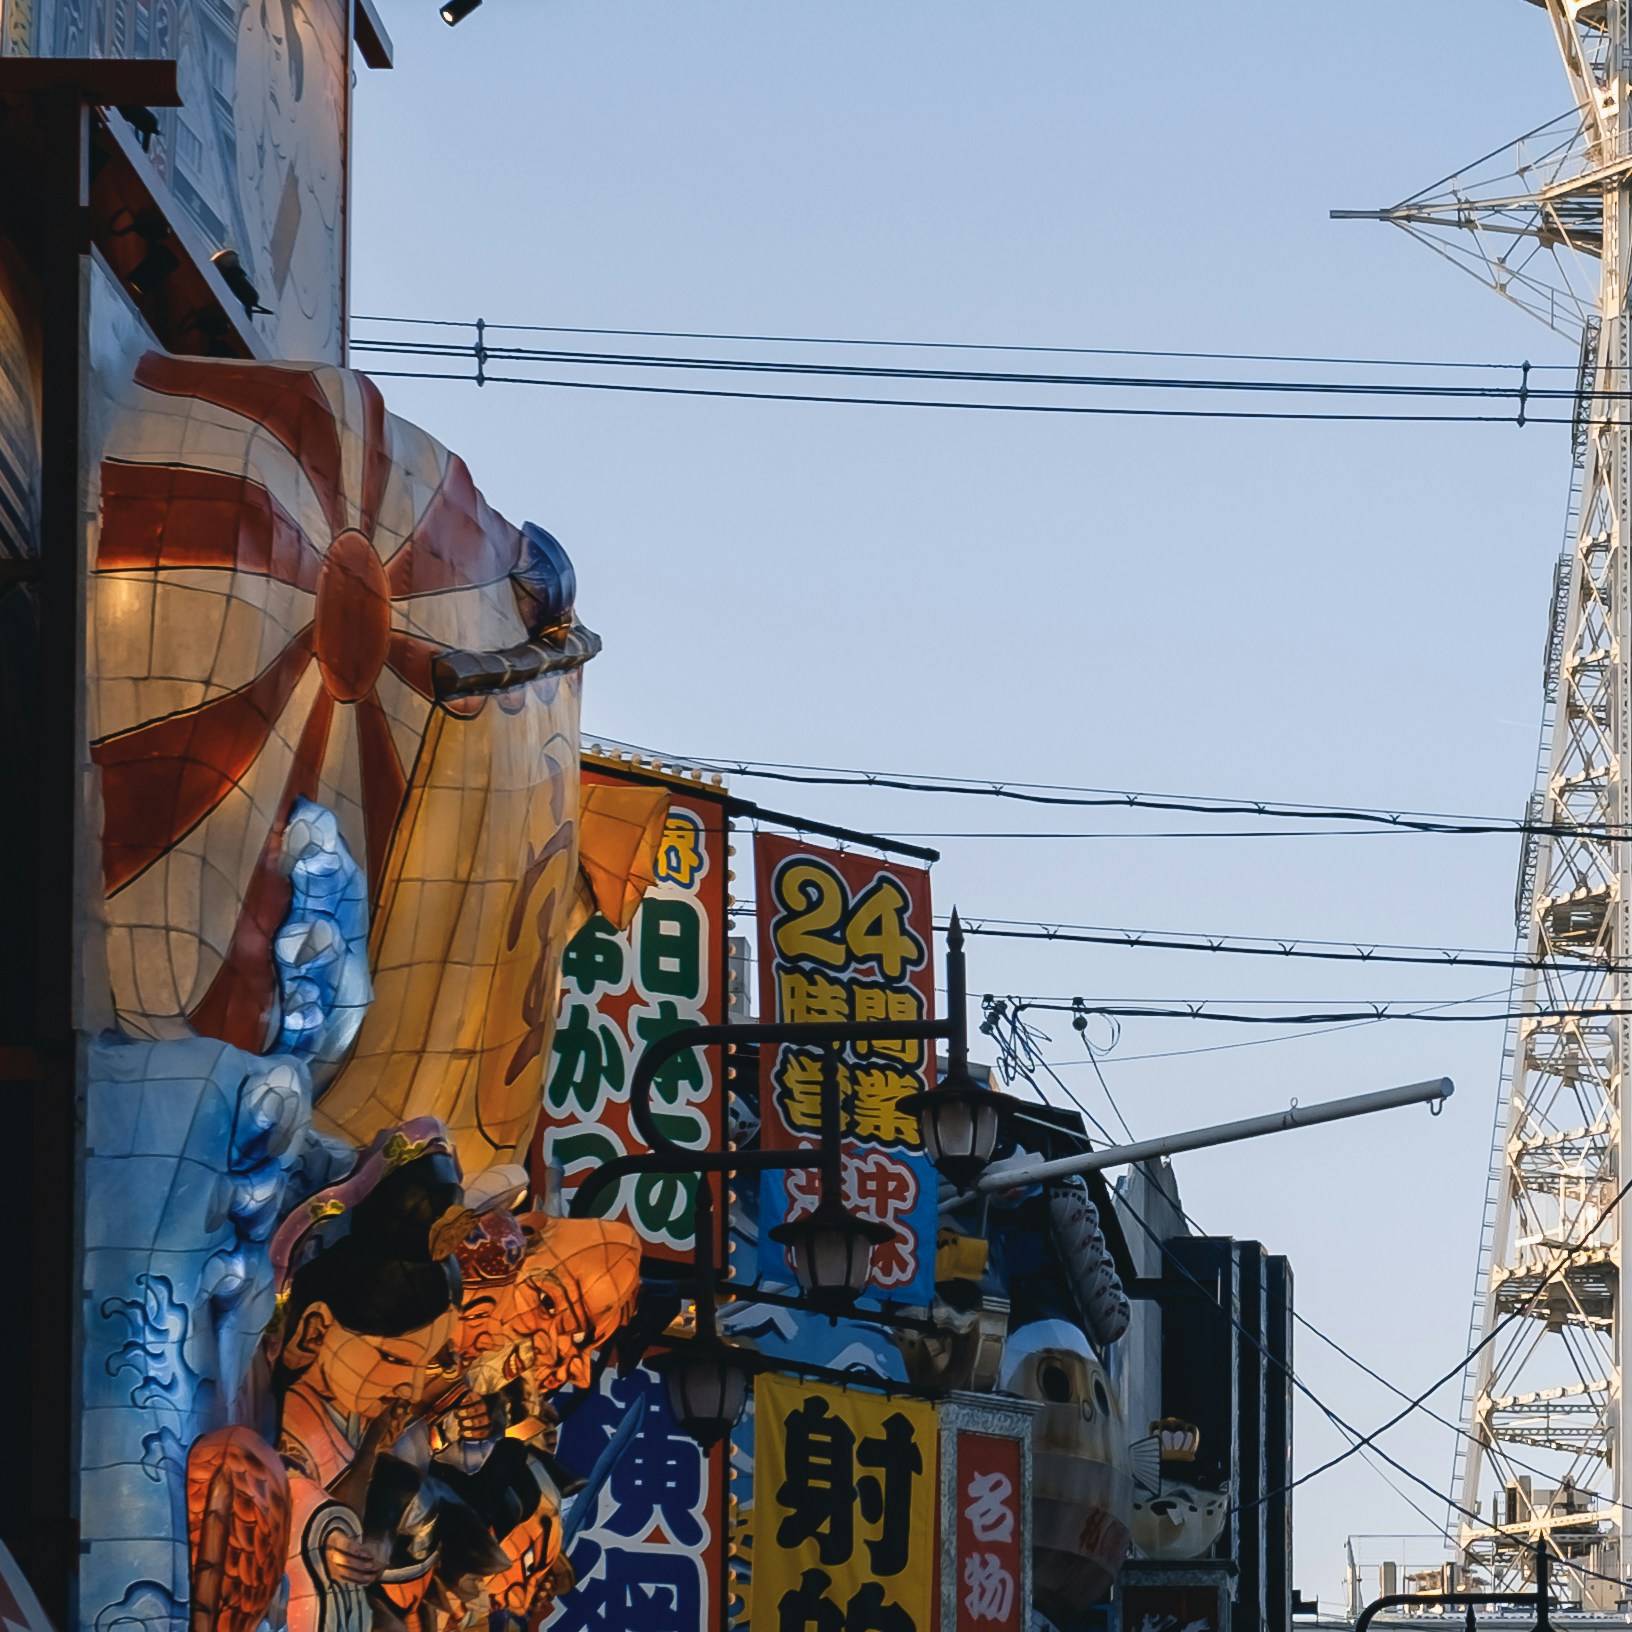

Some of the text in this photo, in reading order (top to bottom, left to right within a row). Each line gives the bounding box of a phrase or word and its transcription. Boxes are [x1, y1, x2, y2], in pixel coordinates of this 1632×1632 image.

[775, 859, 919, 978] 24
[780, 972, 920, 1064] 時間
[783, 1055, 921, 1146] 営業
[963, 1470, 1014, 1624] 名物
